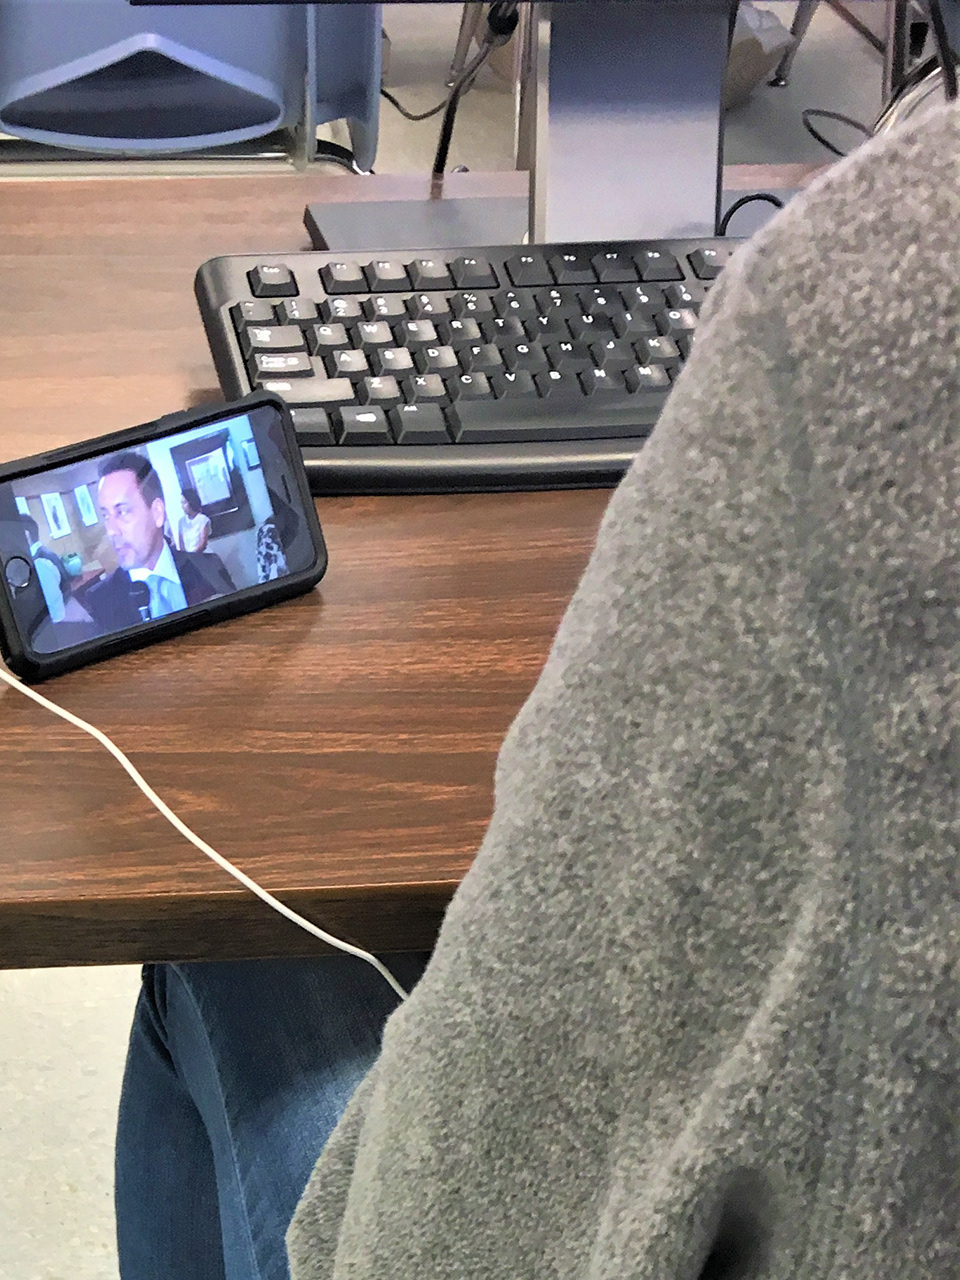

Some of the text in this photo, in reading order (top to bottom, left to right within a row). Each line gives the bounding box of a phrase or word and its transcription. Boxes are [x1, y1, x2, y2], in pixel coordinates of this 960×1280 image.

[597, 297, 606, 305] 8
[639, 295, 649, 303] 9
[682, 293, 691, 301] 0
[510, 300, 520, 309] 6
[553, 298, 562, 307] 7
[336, 307, 346, 316] 2
[378, 305, 388, 314] 3
[423, 303, 433, 312] 4
[625, 313, 632, 321] I
[669, 310, 681, 319] O
[495, 318, 504, 327] T
[538, 316, 549, 325] Y
[582, 315, 593, 324] U
[363, 324, 378, 333] W
[407, 322, 418, 331] E
[451, 321, 463, 329] R
[319, 326, 332, 335] Q
[560, 342, 572, 351] H
[606, 341, 616, 349] J
[648, 338, 660, 347] K
[428, 348, 439, 357] D
[472, 346, 481, 354] F
[517, 345, 529, 353] G
[340, 353, 352, 362] A
[384, 350, 395, 359] S
[550, 371, 561, 380] B
[594, 369, 606, 377] N
[639, 367, 652, 375] M
[415, 376, 427, 386] X
[460, 375, 473, 384] C
[505, 373, 516, 382] V
[371, 378, 383, 388] Z
